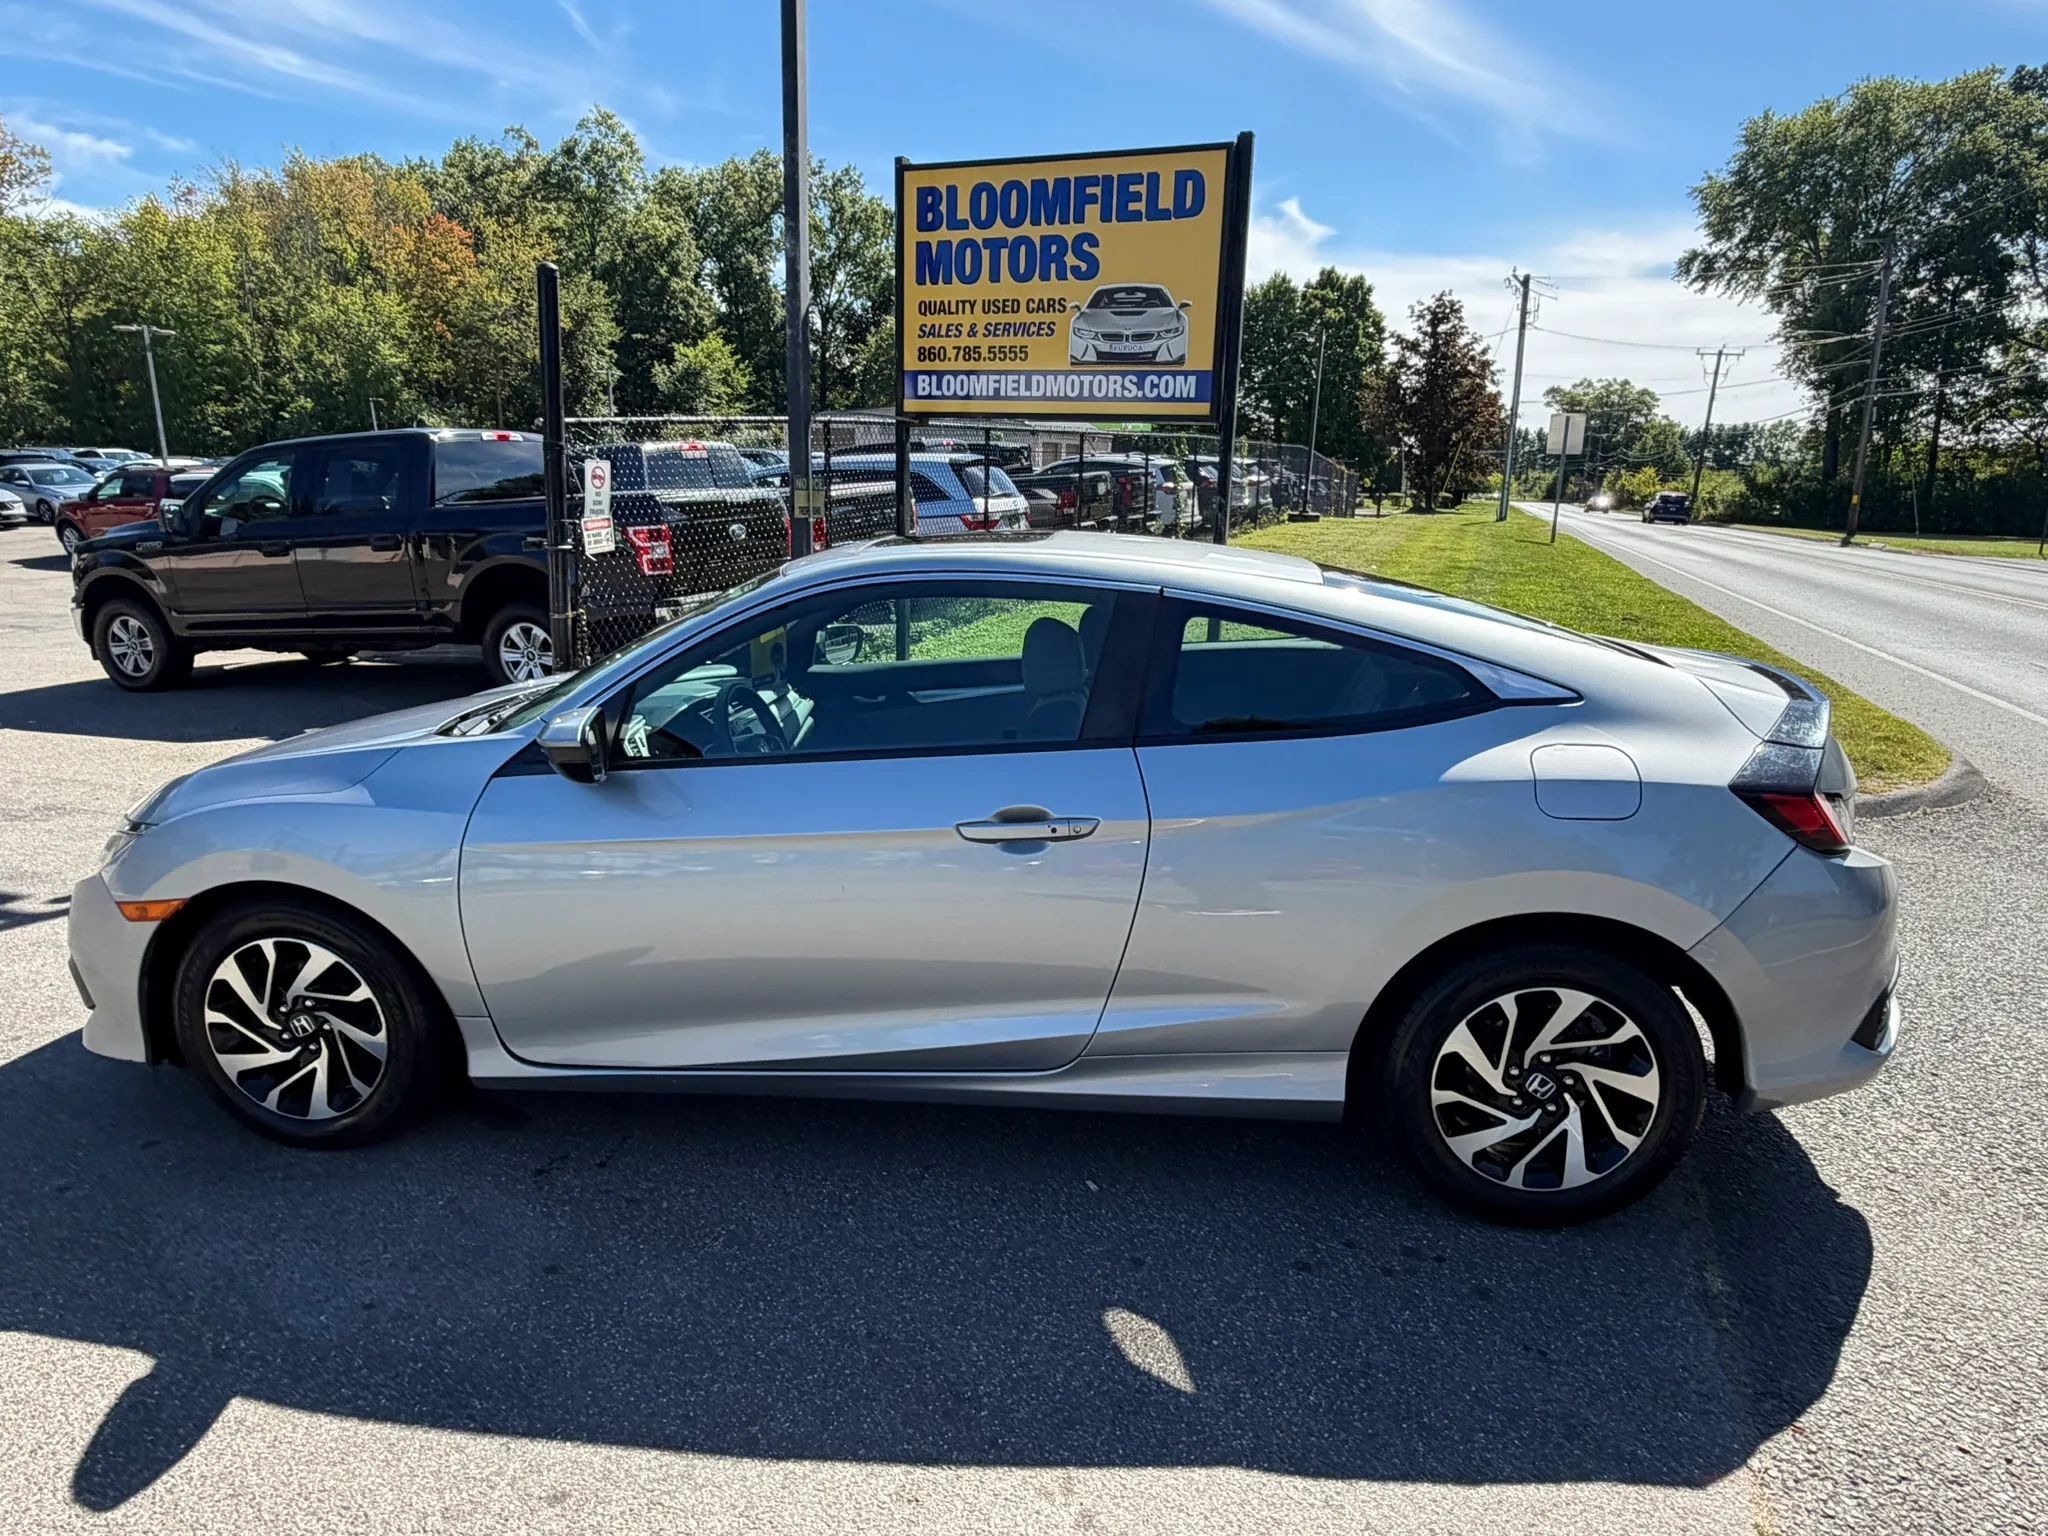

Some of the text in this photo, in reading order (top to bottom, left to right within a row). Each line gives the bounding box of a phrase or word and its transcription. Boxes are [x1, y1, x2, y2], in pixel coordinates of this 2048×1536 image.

[916, 169, 1206, 232] BLOOMFIELD
[915, 232, 1101, 286] MOTORS
[918, 297, 1068, 317] QUALITY USED CARS
[917, 321, 1057, 339] SALES & SERVICES
[917, 345, 1029, 363] 860.785.5555
[917, 374, 1197, 398] BLOOMFIELDMOTORS.COM
[795, 478, 825, 491] NOCE
